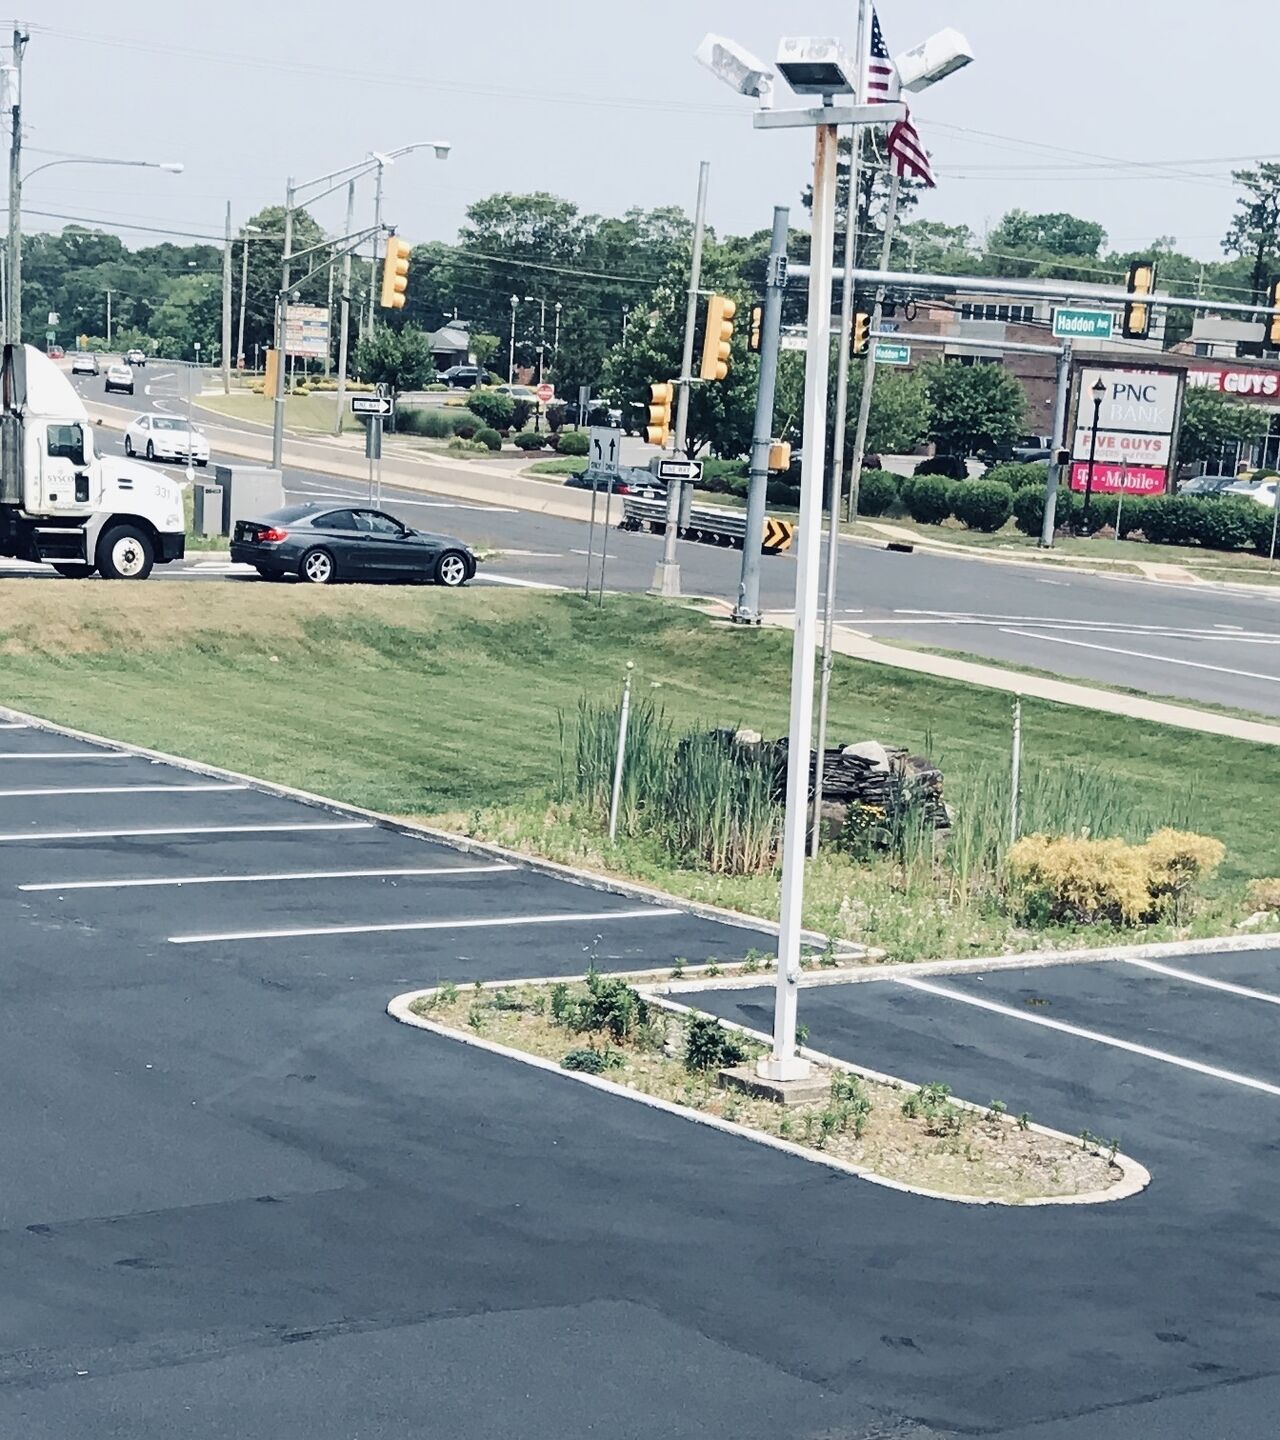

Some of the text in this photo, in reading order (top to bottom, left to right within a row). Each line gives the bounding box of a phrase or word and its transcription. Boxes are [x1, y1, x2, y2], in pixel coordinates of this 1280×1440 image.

[1057, 314, 1095, 332] Haddon
[1112, 383, 1157, 403] PNC
[1223, 373, 1278, 395] GUYS
[1111, 404, 1167, 424] BANK
[1082, 434, 1162, 452] FVE GUYS
